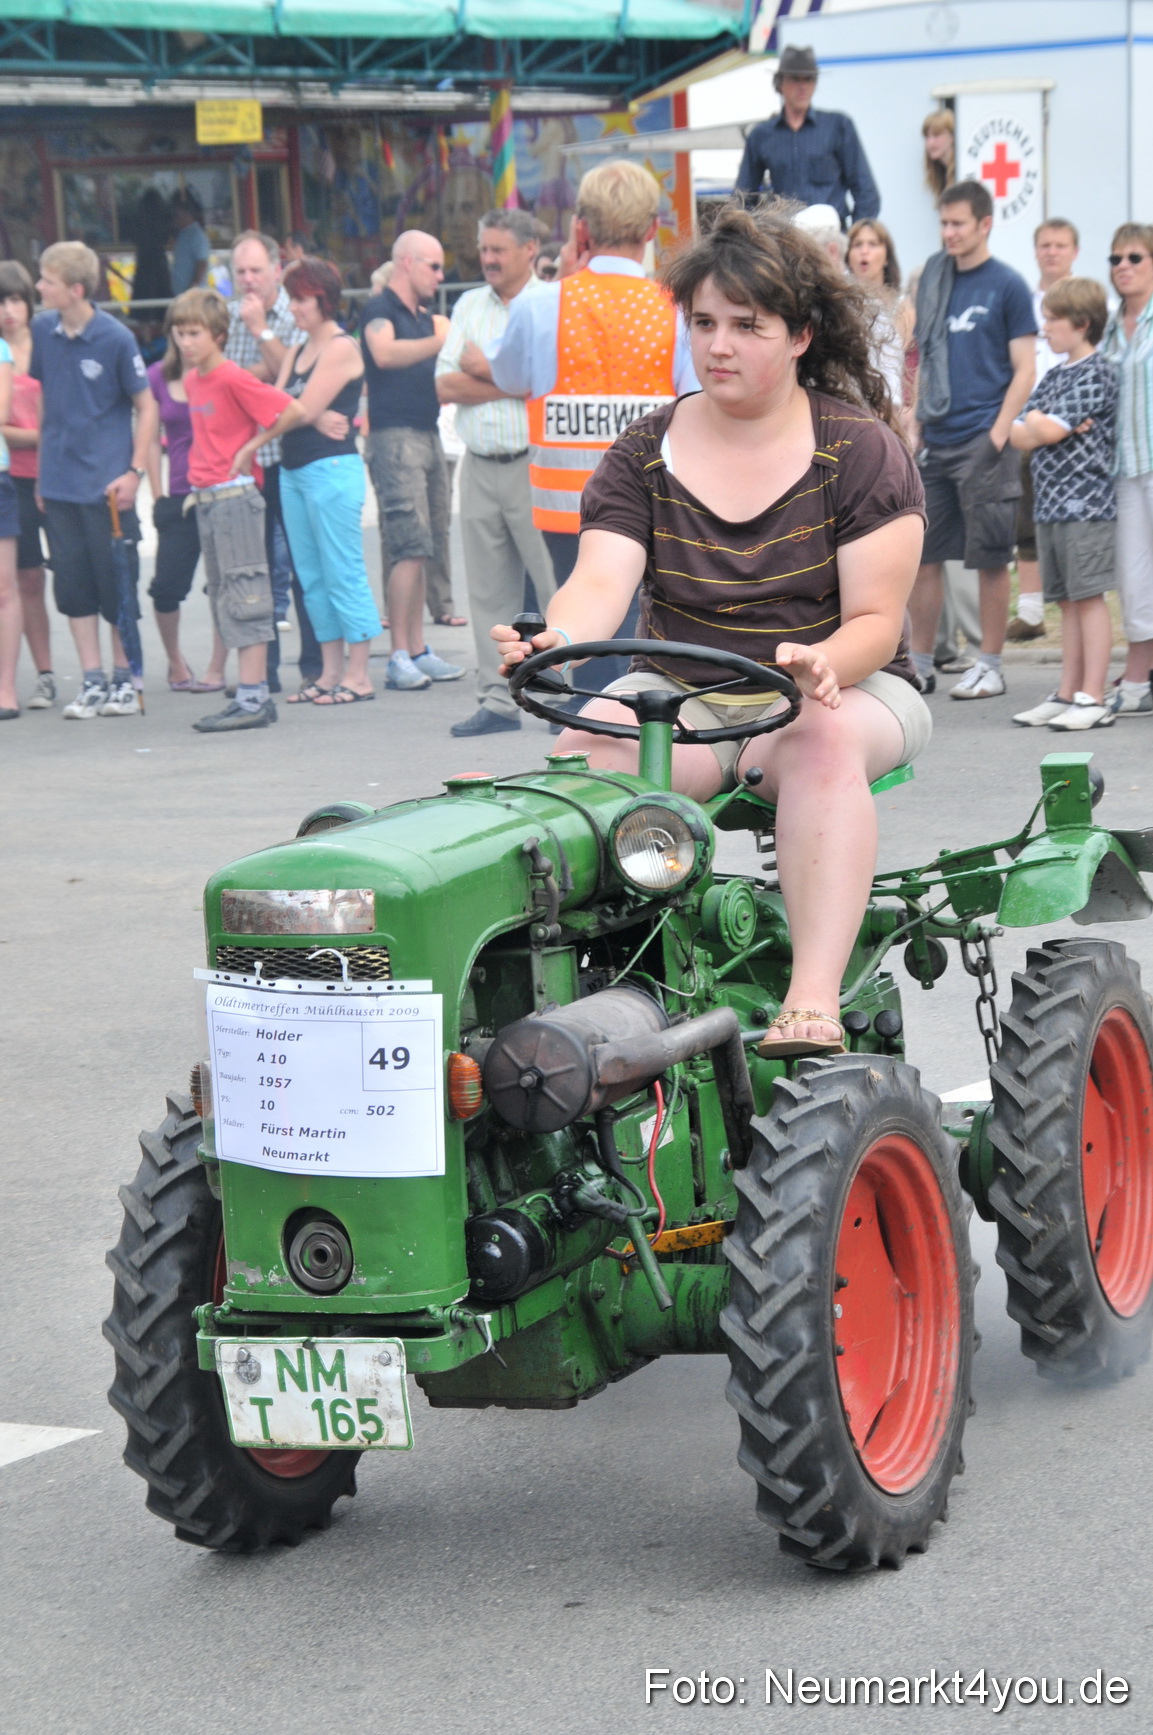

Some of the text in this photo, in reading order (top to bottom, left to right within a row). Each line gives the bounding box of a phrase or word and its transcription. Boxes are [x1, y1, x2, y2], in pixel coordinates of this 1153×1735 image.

[967, 119, 1034, 158] DEUTSCHES
[1002, 170, 1037, 220] KREUZ
[546, 402, 668, 436] FEUERW
[214, 996, 420, 1017] Oldtimertreffen Mühlhausen 2009
[215, 1024, 303, 1042] Hersteller: Holder
[217, 1048, 287, 1065] Typ: A 10
[368, 1046, 411, 1071] 49
[219, 1071, 292, 1089] Baujahr: 1957
[259, 1099, 275, 1111] 10
[366, 1104, 396, 1117] 502
[222, 1118, 347, 1140] Halter: Fürst Martin
[262, 1145, 330, 1163] Neumarkt
[274, 1348, 348, 1393] NM
[249, 1396, 385, 1442] T 165
